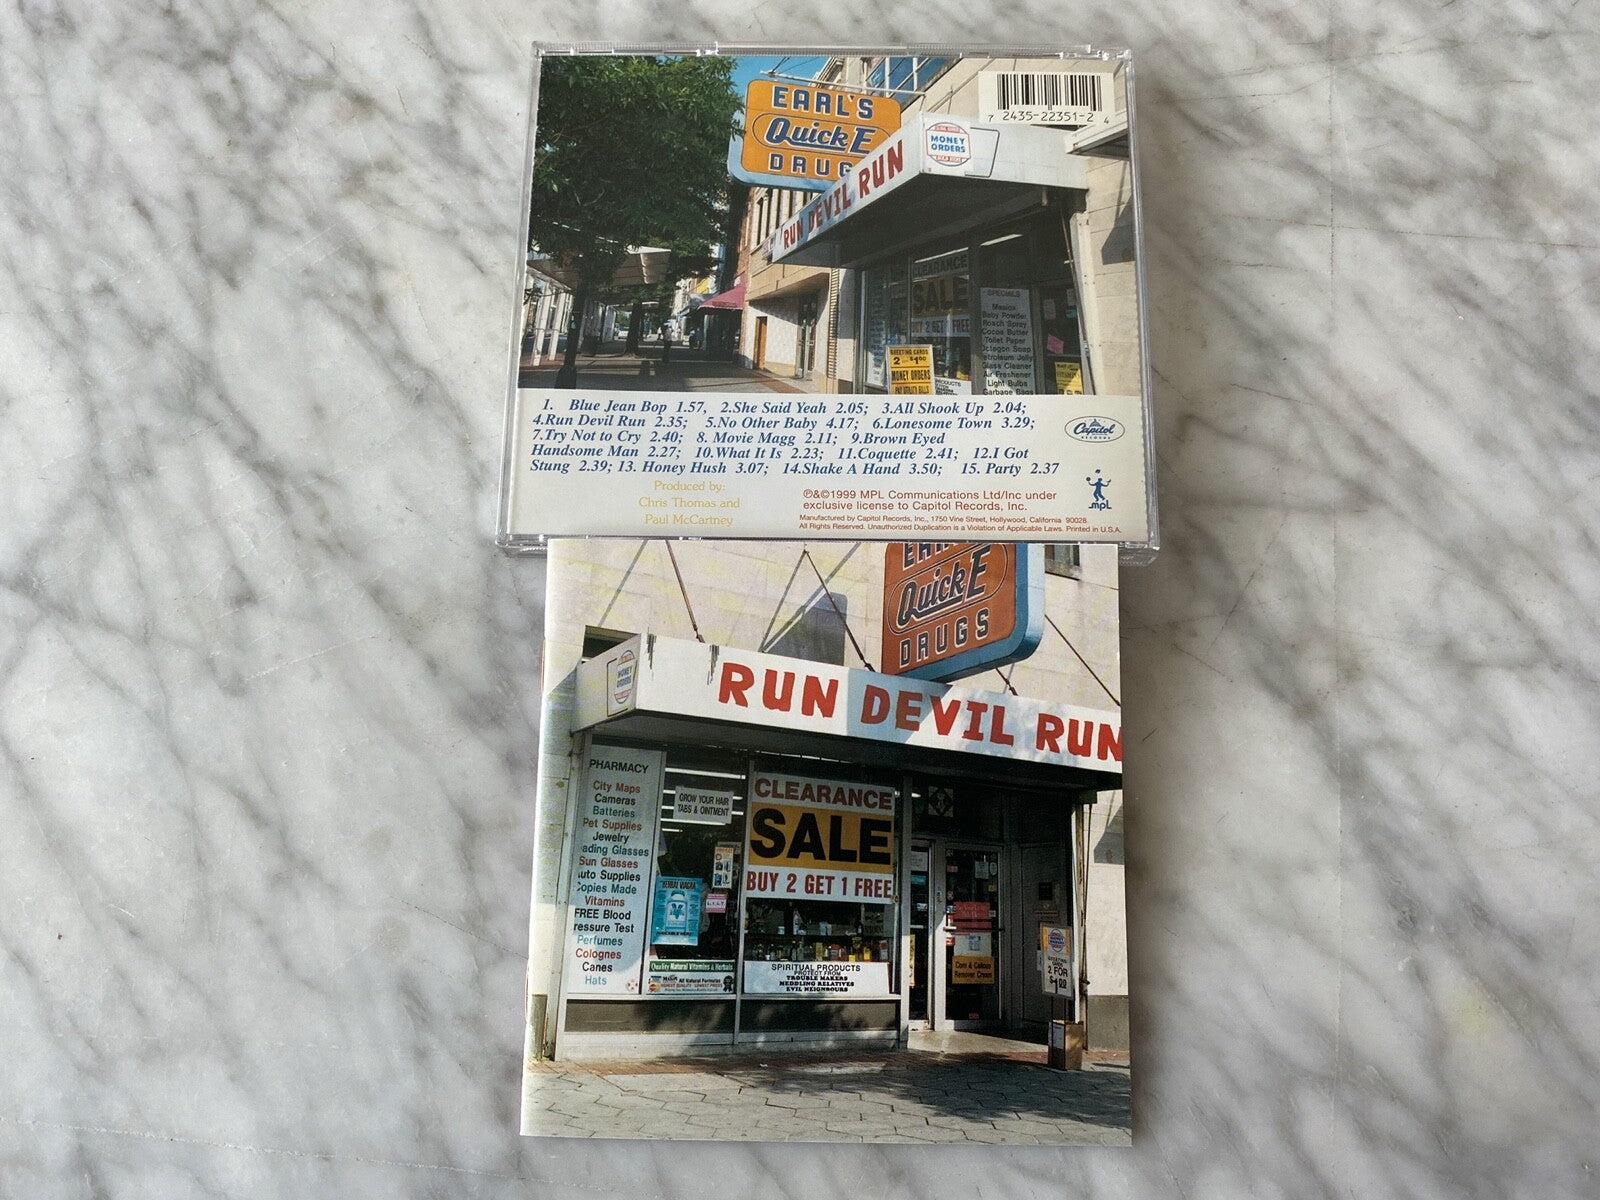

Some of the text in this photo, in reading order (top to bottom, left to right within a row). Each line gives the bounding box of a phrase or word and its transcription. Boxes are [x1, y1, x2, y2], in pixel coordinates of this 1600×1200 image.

[773, 86, 874, 119] EARL'S
[988, 114, 994, 122] 7
[1002, 111, 1094, 122] 2435-22351-2
[765, 117, 877, 154] Quick E
[930, 135, 965, 145] MONEY
[930, 144, 966, 153] ORDERS
[784, 140, 904, 250] RUN DEVIL RUN
[891, 370, 930, 380] MONEY ORDERS
[542, 399, 1026, 416] 1. Blue Jean Bop 1.57, 2.She Said Yeah 2.05; 3.All Shook Up 2.04;
[532, 414, 1035, 432] 4.Run Devil Run 2.35; 5.No Other Baby 4.17; 6.Lonesome Town 3.29;
[1074, 422, 1116, 435] Capitol
[533, 429, 946, 447] 7.Try Not to Cry 2.40; 8. Movie Magg 2.11; 9.Brown Eyed
[531, 444, 1029, 462] Handsome Man 2.27; 10.What It Is 2.23; 11.Coquette 2.41; 12.I Got
[530, 459, 1060, 477] Stung 2.39; 13. Honey Hush 3.07; 14.Shake A Hand 3.50; 15. Party 2.37
[654, 480, 726, 494] Produced by:
[860, 490, 884, 499] MPL
[888, 490, 979, 500] Communications
[984, 490, 1022, 500] Ltd/Inc
[1026, 491, 1057, 500] under
[638, 497, 740, 508] Chris Thomas and
[803, 501, 1028, 512] exclusive license to Capitol Records, Inc.
[644, 514, 733, 528] Paul McCartney
[990, 516, 1027, 524] Hollywood,
[896, 560, 966, 628] Quick
[964, 544, 990, 600] E
[900, 608, 989, 668] DRUGS
[718, 662, 1122, 762] RUN DEVIL RUN
[589, 759, 649, 774] PHARMACY
[593, 780, 641, 794] City Maps
[594, 793, 636, 806] Cameras
[679, 793, 729, 805] GROW YOUR HAIR
[754, 778, 893, 810] CLEARANCE
[592, 806, 635, 818] Batteries
[678, 804, 730, 816] TABS & OINTMENT
[583, 818, 642, 831] Pet Supplies
[592, 832, 630, 844] Jewelry
[750, 808, 892, 866] SALE
[580, 856, 638, 868] Sun Glasses
[746, 871, 893, 899] BUY 2 GET 1 FREE
[585, 896, 624, 906] Vitamins
[574, 908, 631, 920] FREE Blood
[577, 935, 623, 946] Perfumes
[576, 948, 622, 960] Colognes
[582, 962, 612, 972] Canes
[817, 964, 860, 972] PRODUCTS
[1048, 966, 1068, 977] 2 FOR
[585, 976, 607, 985] Hats
